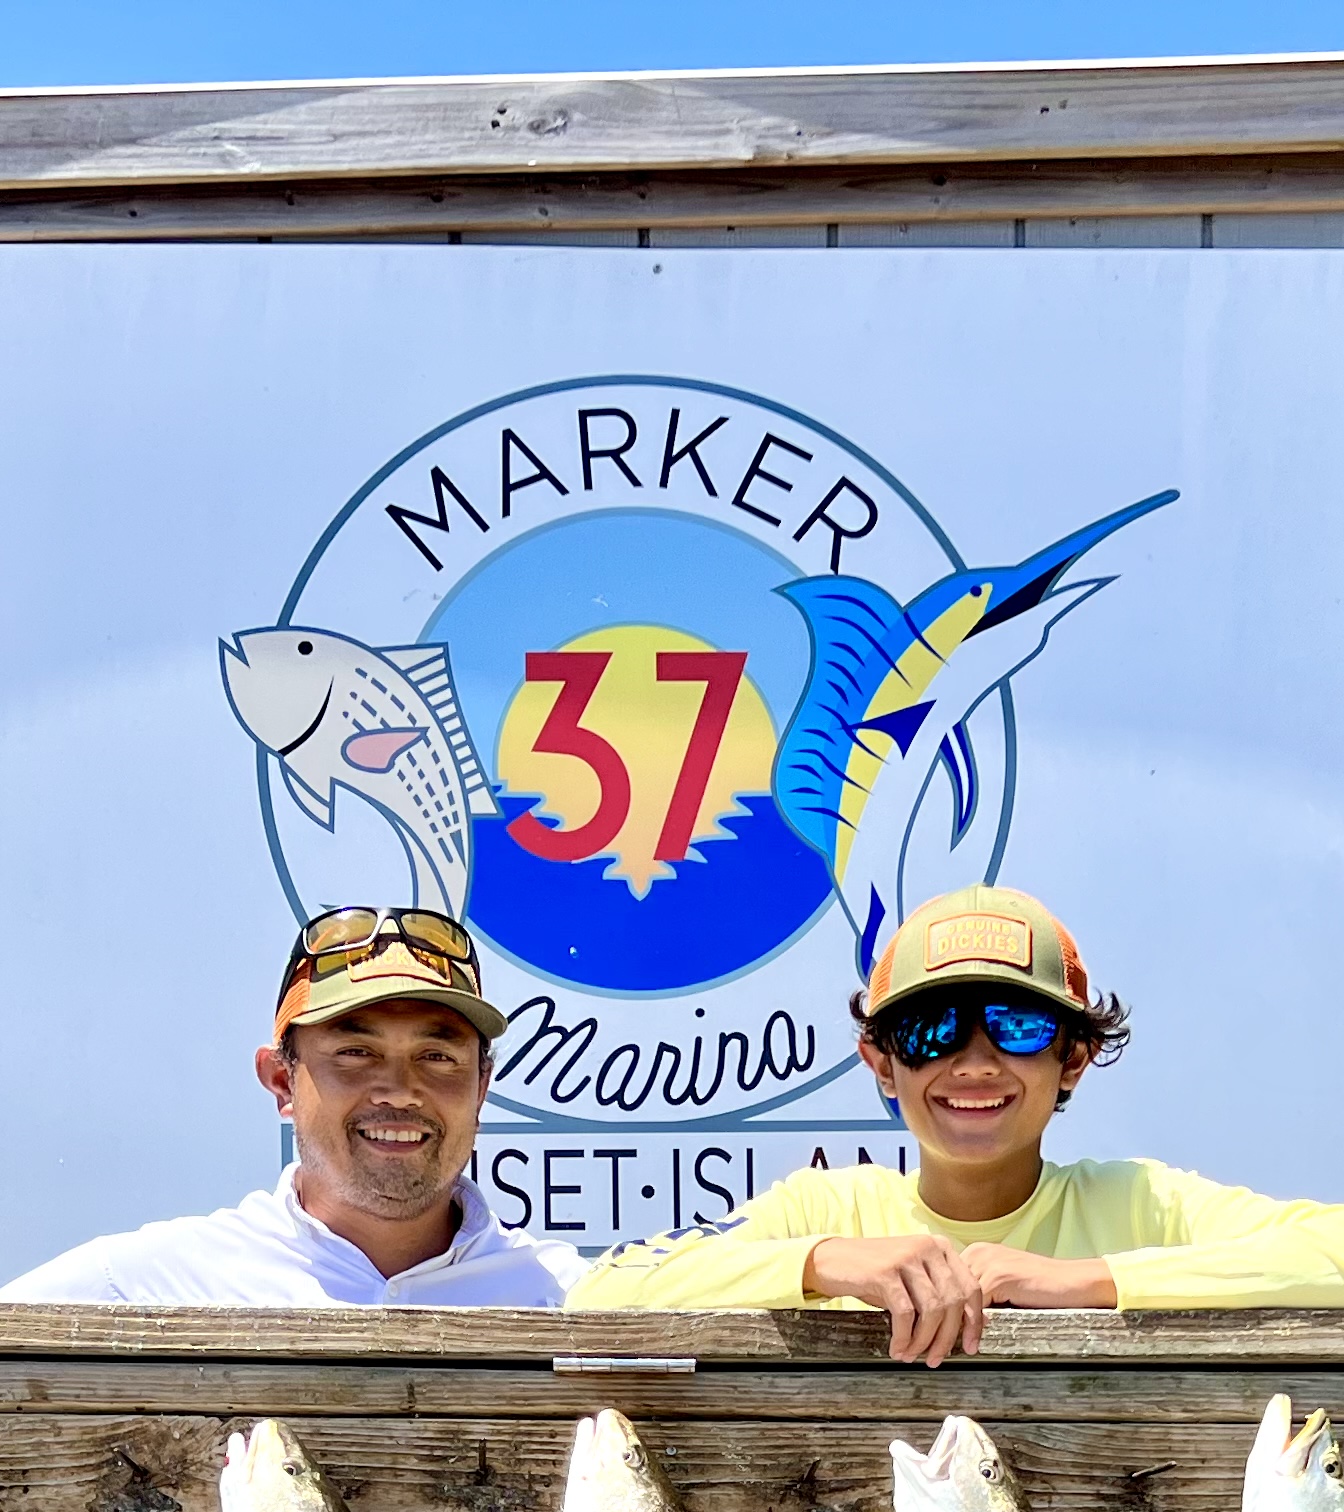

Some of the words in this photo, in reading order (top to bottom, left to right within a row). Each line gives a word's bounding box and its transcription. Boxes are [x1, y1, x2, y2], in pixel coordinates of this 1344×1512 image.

[385, 406, 879, 574] MARKER
[505, 650, 748, 863] 37
[937, 933, 1019, 956] DICKIES
[495, 995, 816, 1112] Marina
